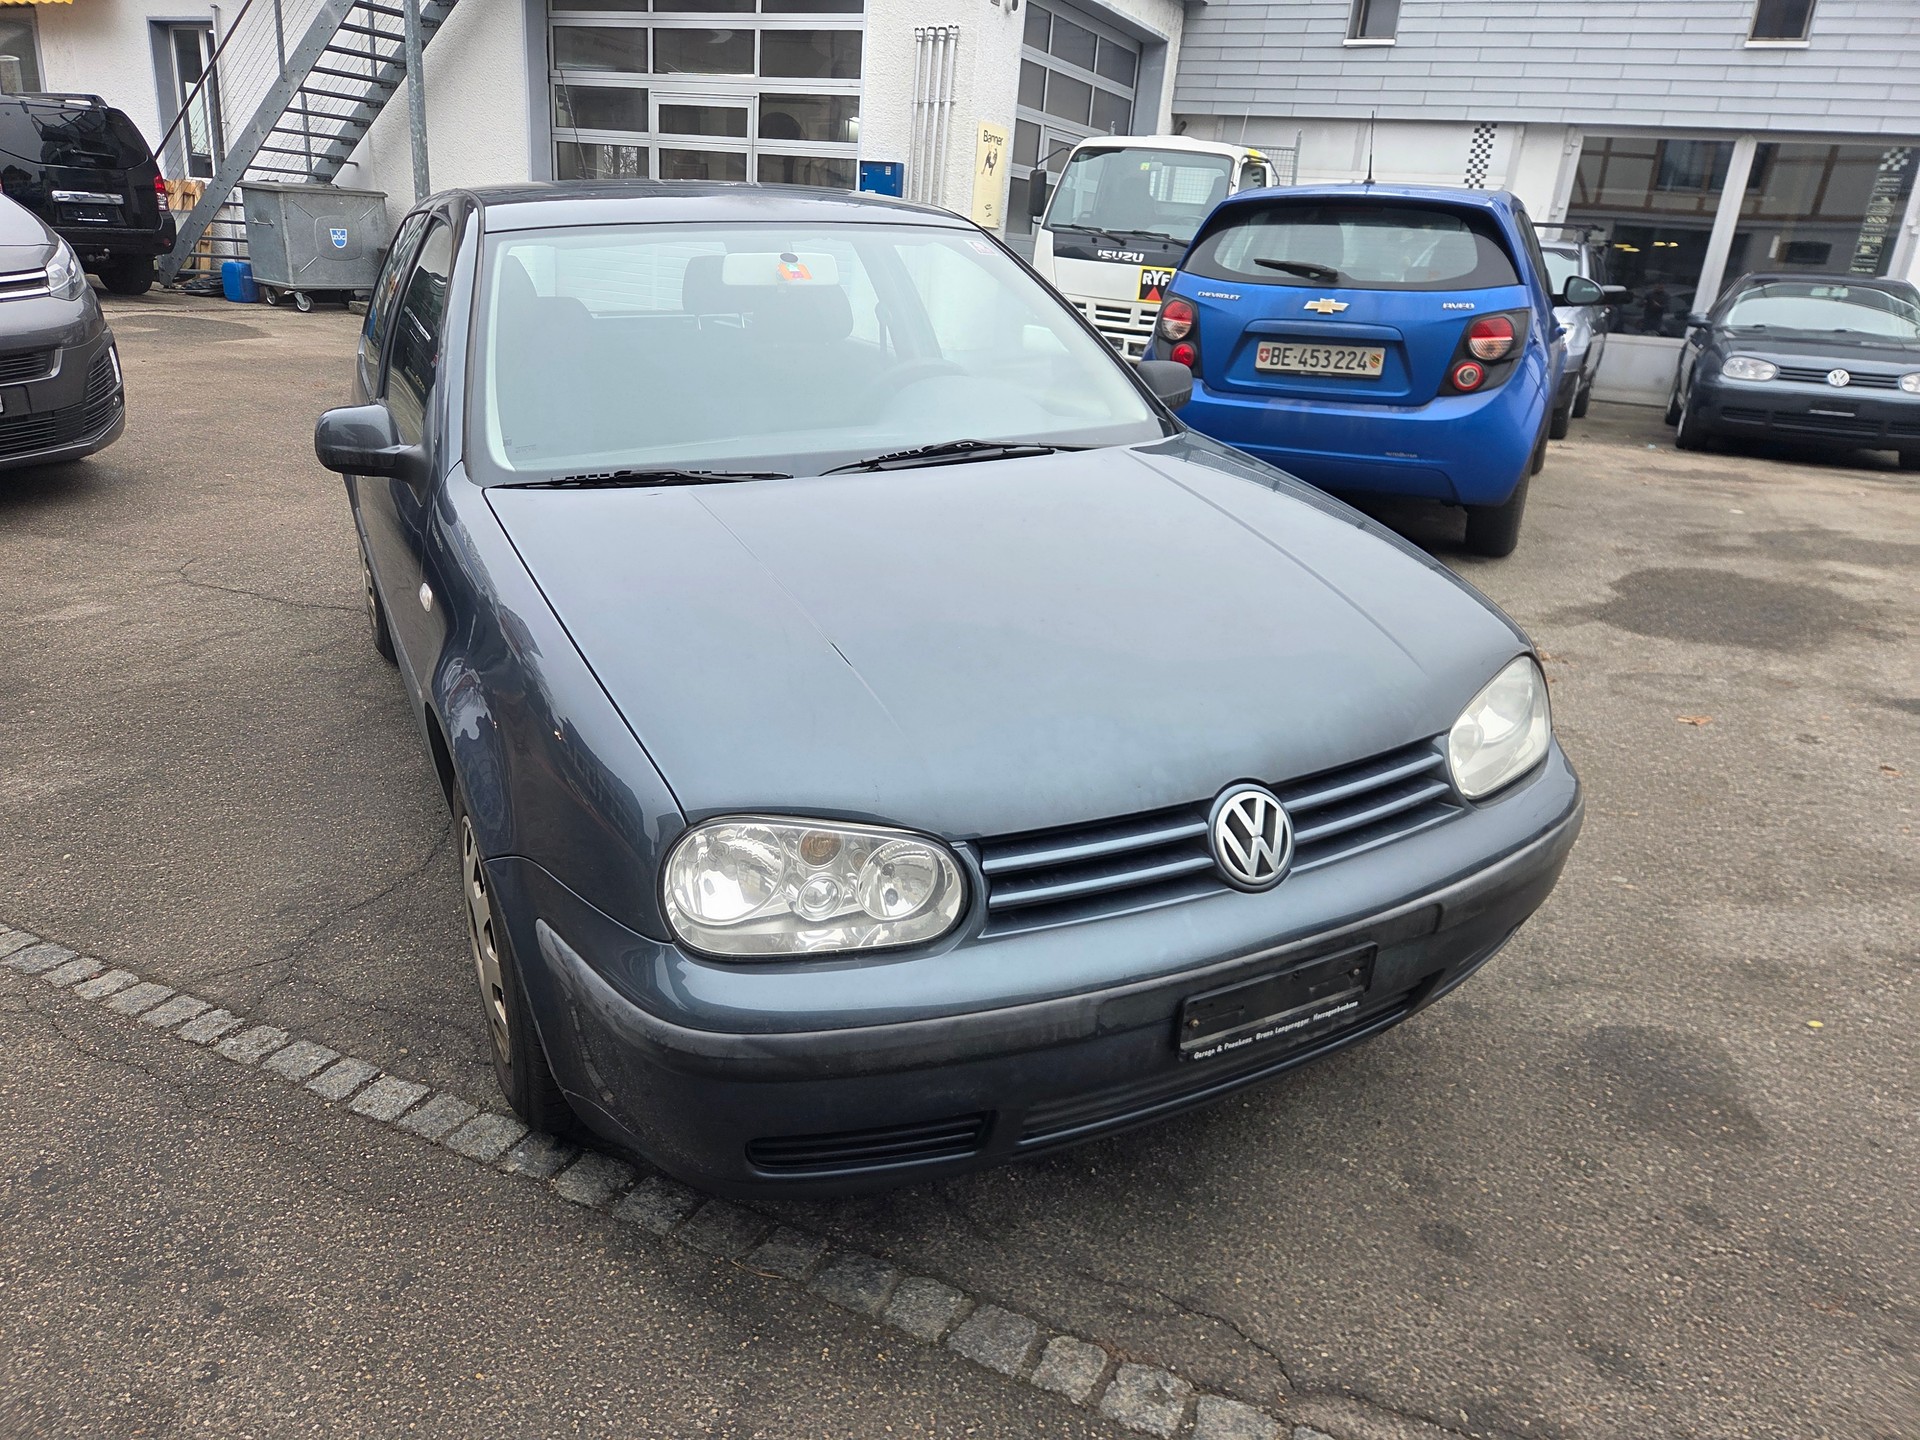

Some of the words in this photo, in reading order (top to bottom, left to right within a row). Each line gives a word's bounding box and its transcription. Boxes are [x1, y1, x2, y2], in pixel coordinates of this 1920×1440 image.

[983, 129, 1004, 146] Banner
[1097, 249, 1145, 263] ISUZU
[1142, 270, 1171, 286] RYF
[1198, 291, 1241, 300] CHEVROLET
[1442, 302, 1475, 310] AVEO
[1215, 791, 1292, 885] VW
[1193, 1048, 1216, 1060] Garage
[1216, 1044, 1223, 1053] &
